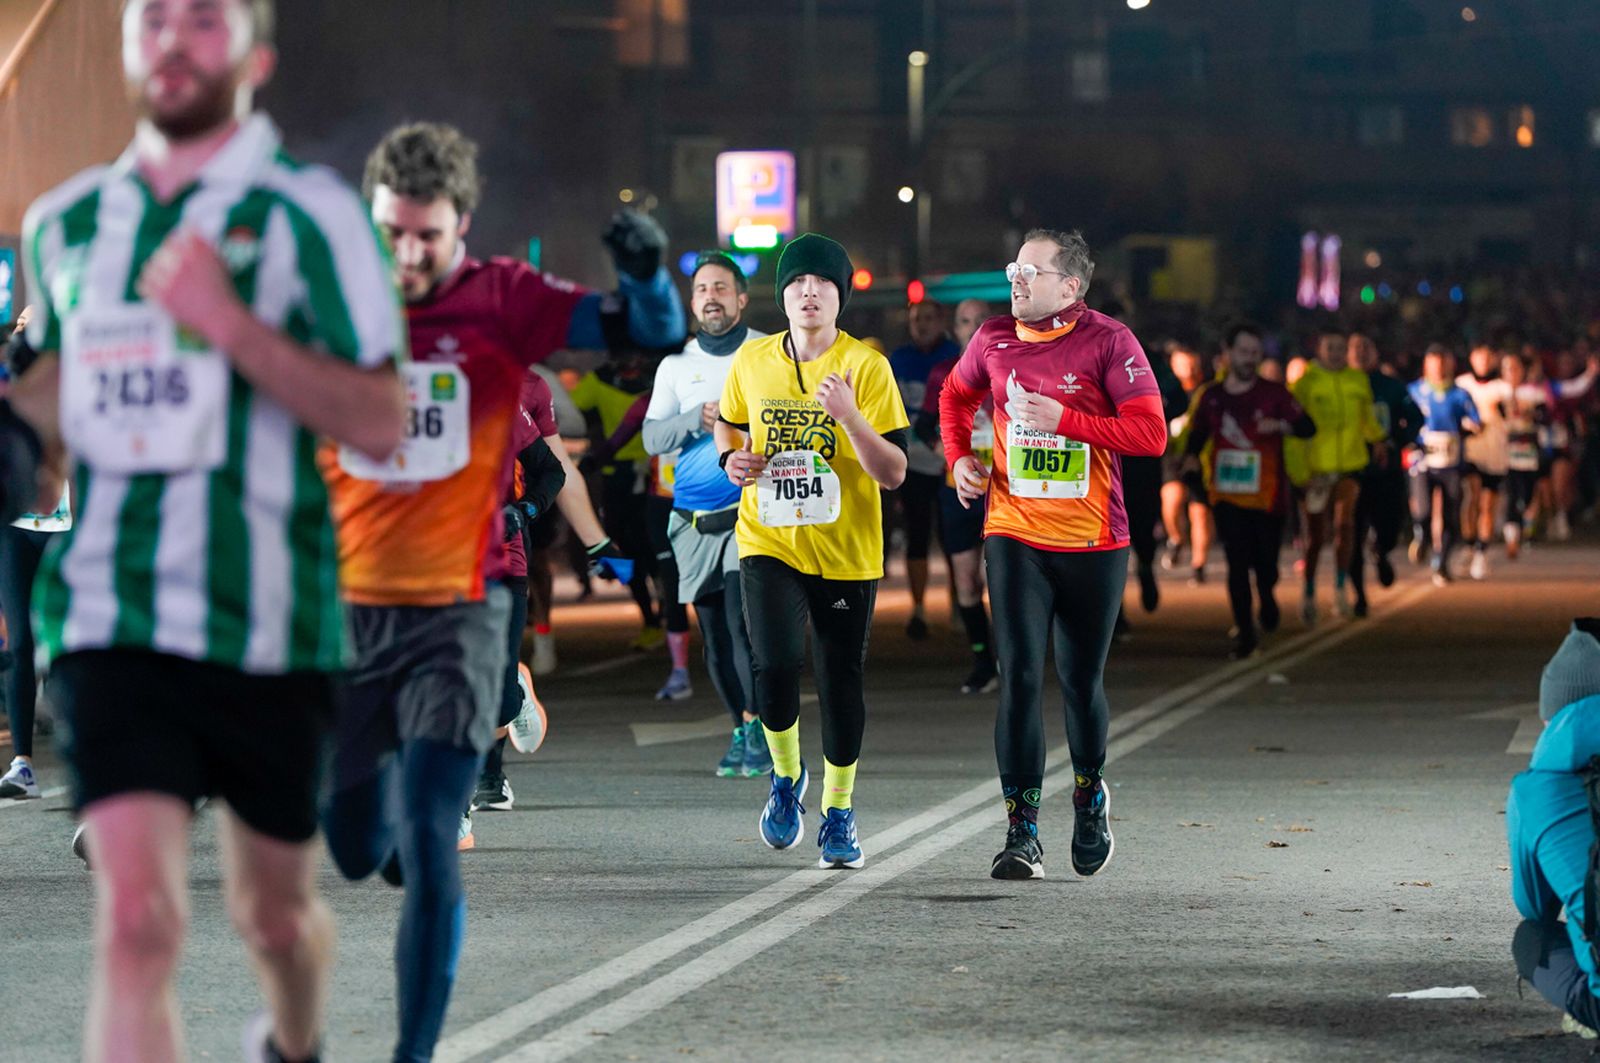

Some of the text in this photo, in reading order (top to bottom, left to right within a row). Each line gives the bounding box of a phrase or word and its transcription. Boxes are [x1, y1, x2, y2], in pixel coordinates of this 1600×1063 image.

[761, 399, 824, 408] TORREDELCA
[761, 408, 836, 427] CRESTA
[768, 427, 800, 443] DEL
[1014, 438, 1029, 446] SAN
[1031, 439, 1058, 448] ANTON
[773, 459, 806, 467] NOCHE DE
[1022, 448, 1071, 473] 7057
[772, 476, 824, 500] 7054
